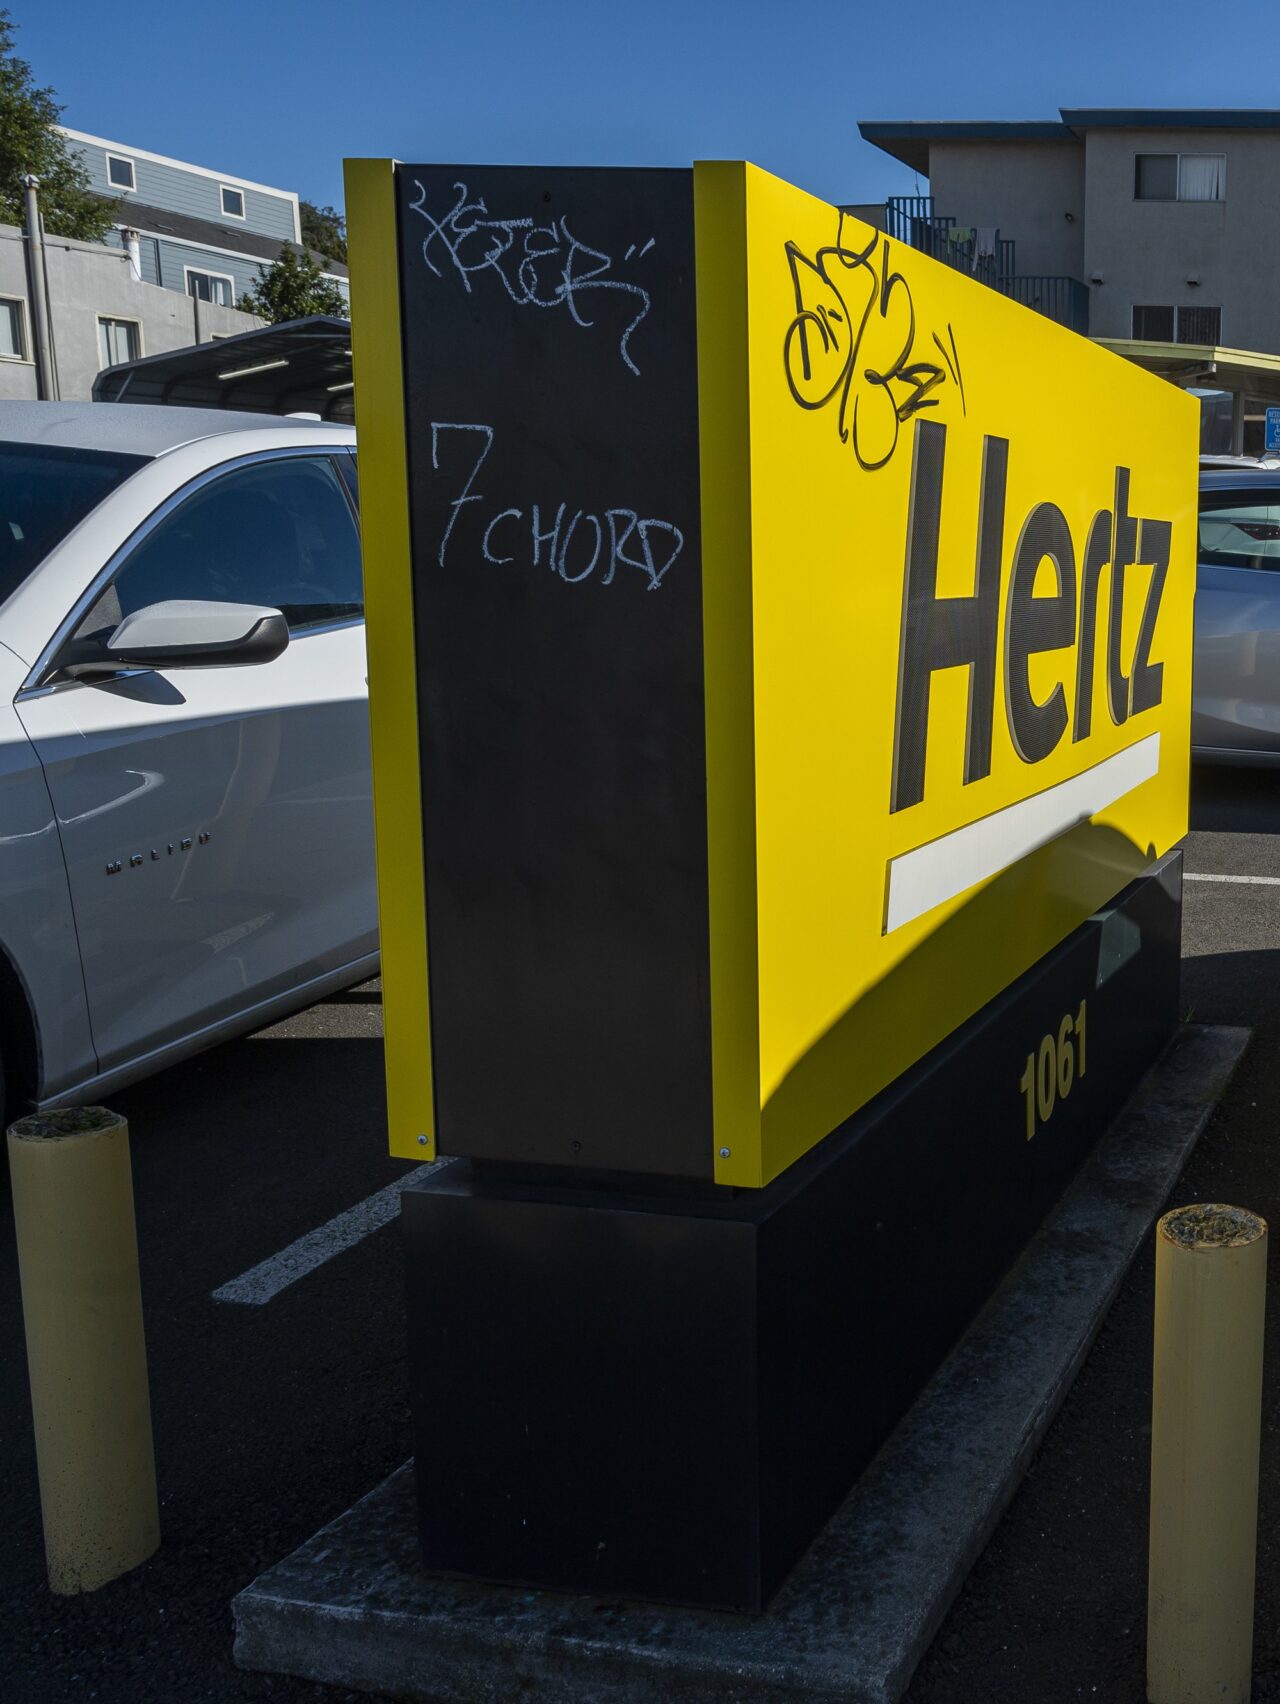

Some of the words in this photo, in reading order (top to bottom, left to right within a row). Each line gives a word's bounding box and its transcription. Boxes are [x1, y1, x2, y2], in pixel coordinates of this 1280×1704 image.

[430, 421, 494, 568] 7
[482, 502, 684, 591] CHORD
[890, 418, 1172, 815] Hertz
[105, 831, 212, 876] MALIBU
[1020, 999, 1087, 1142] 1061
